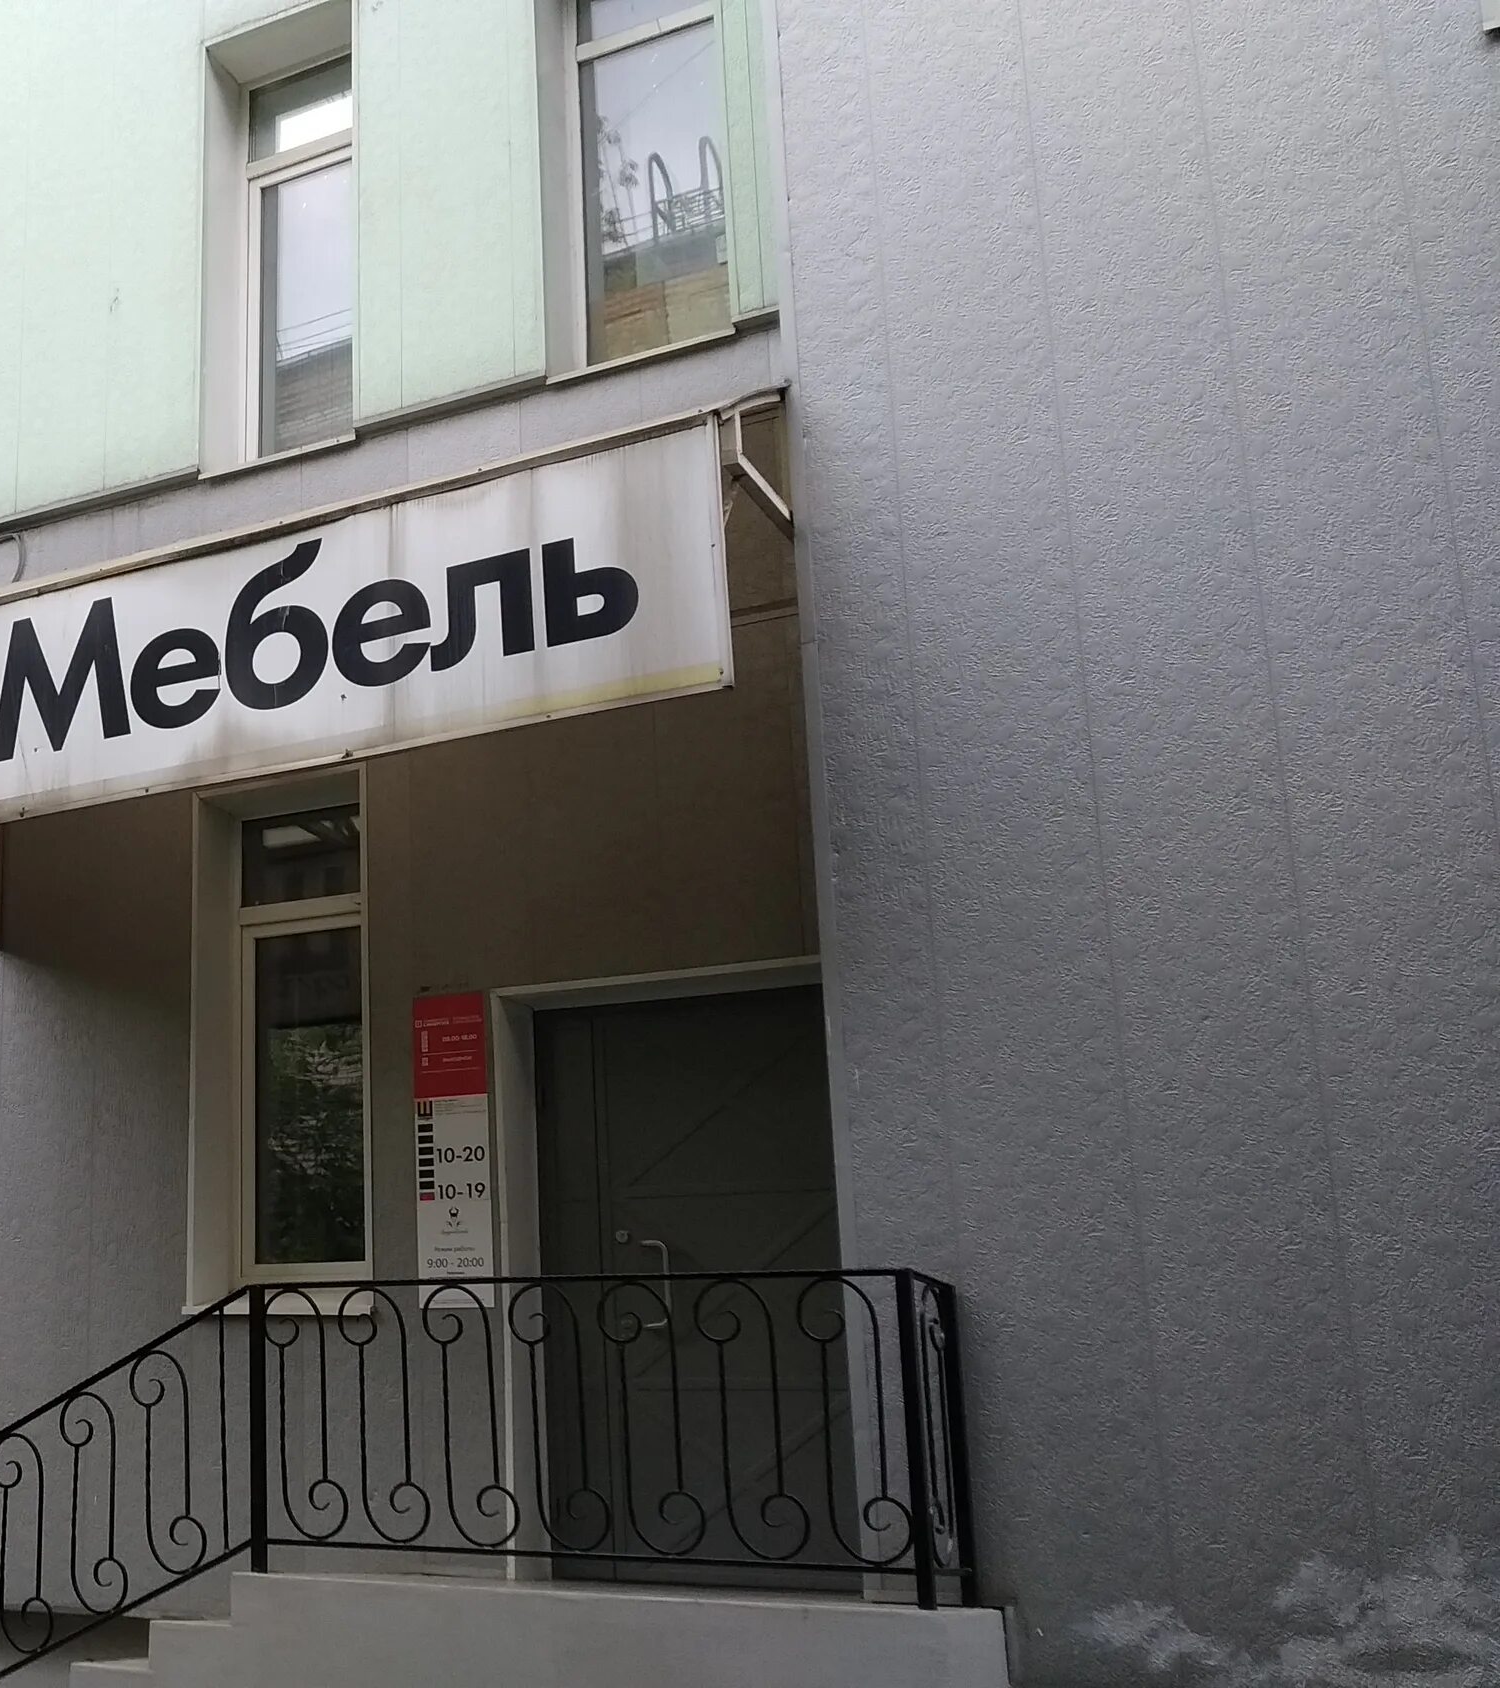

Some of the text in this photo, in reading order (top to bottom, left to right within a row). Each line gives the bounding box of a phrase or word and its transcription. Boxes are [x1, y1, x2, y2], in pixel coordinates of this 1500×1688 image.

[436, 1145, 486, 1163] 10-20
[438, 1182, 486, 1199] 10-19
[427, 1258, 449, 1268] 9:00
[457, 1257, 485, 1267] 20:00
